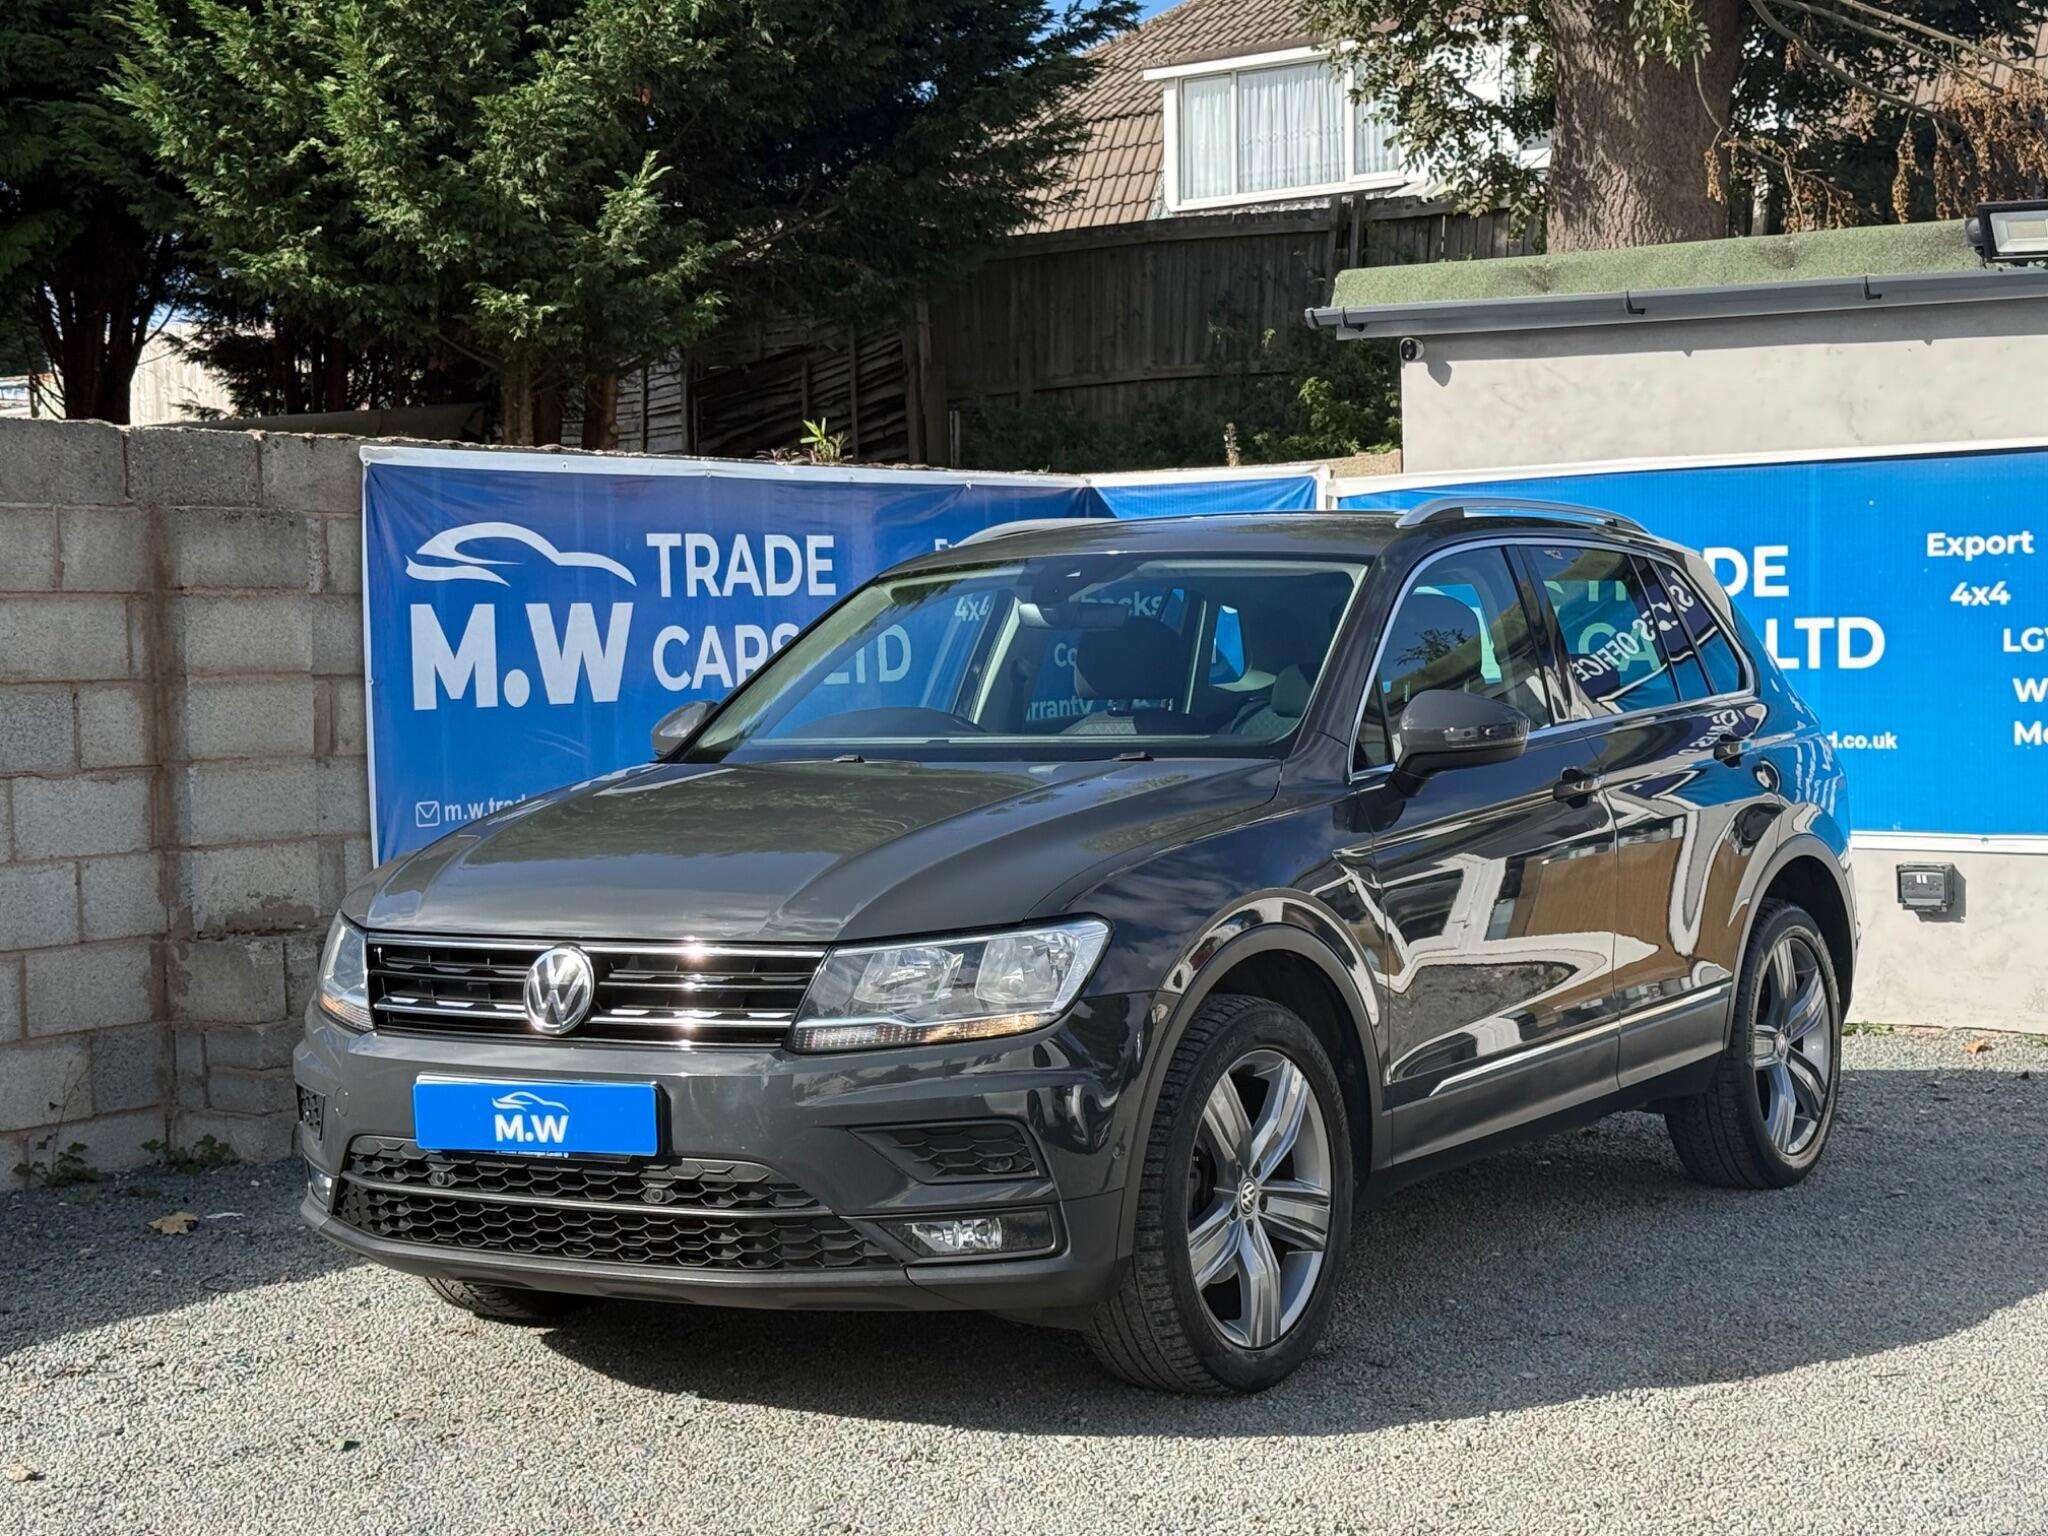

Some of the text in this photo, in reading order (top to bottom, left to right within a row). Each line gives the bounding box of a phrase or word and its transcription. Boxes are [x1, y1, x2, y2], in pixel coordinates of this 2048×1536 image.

[647, 533, 837, 598] TRADE
[1926, 530, 2035, 562] Export
[1950, 581, 2011, 606] 4x4
[411, 602, 634, 711] M.W
[1766, 616, 1885, 669] LTD
[494, 1114, 569, 1144] M.W
